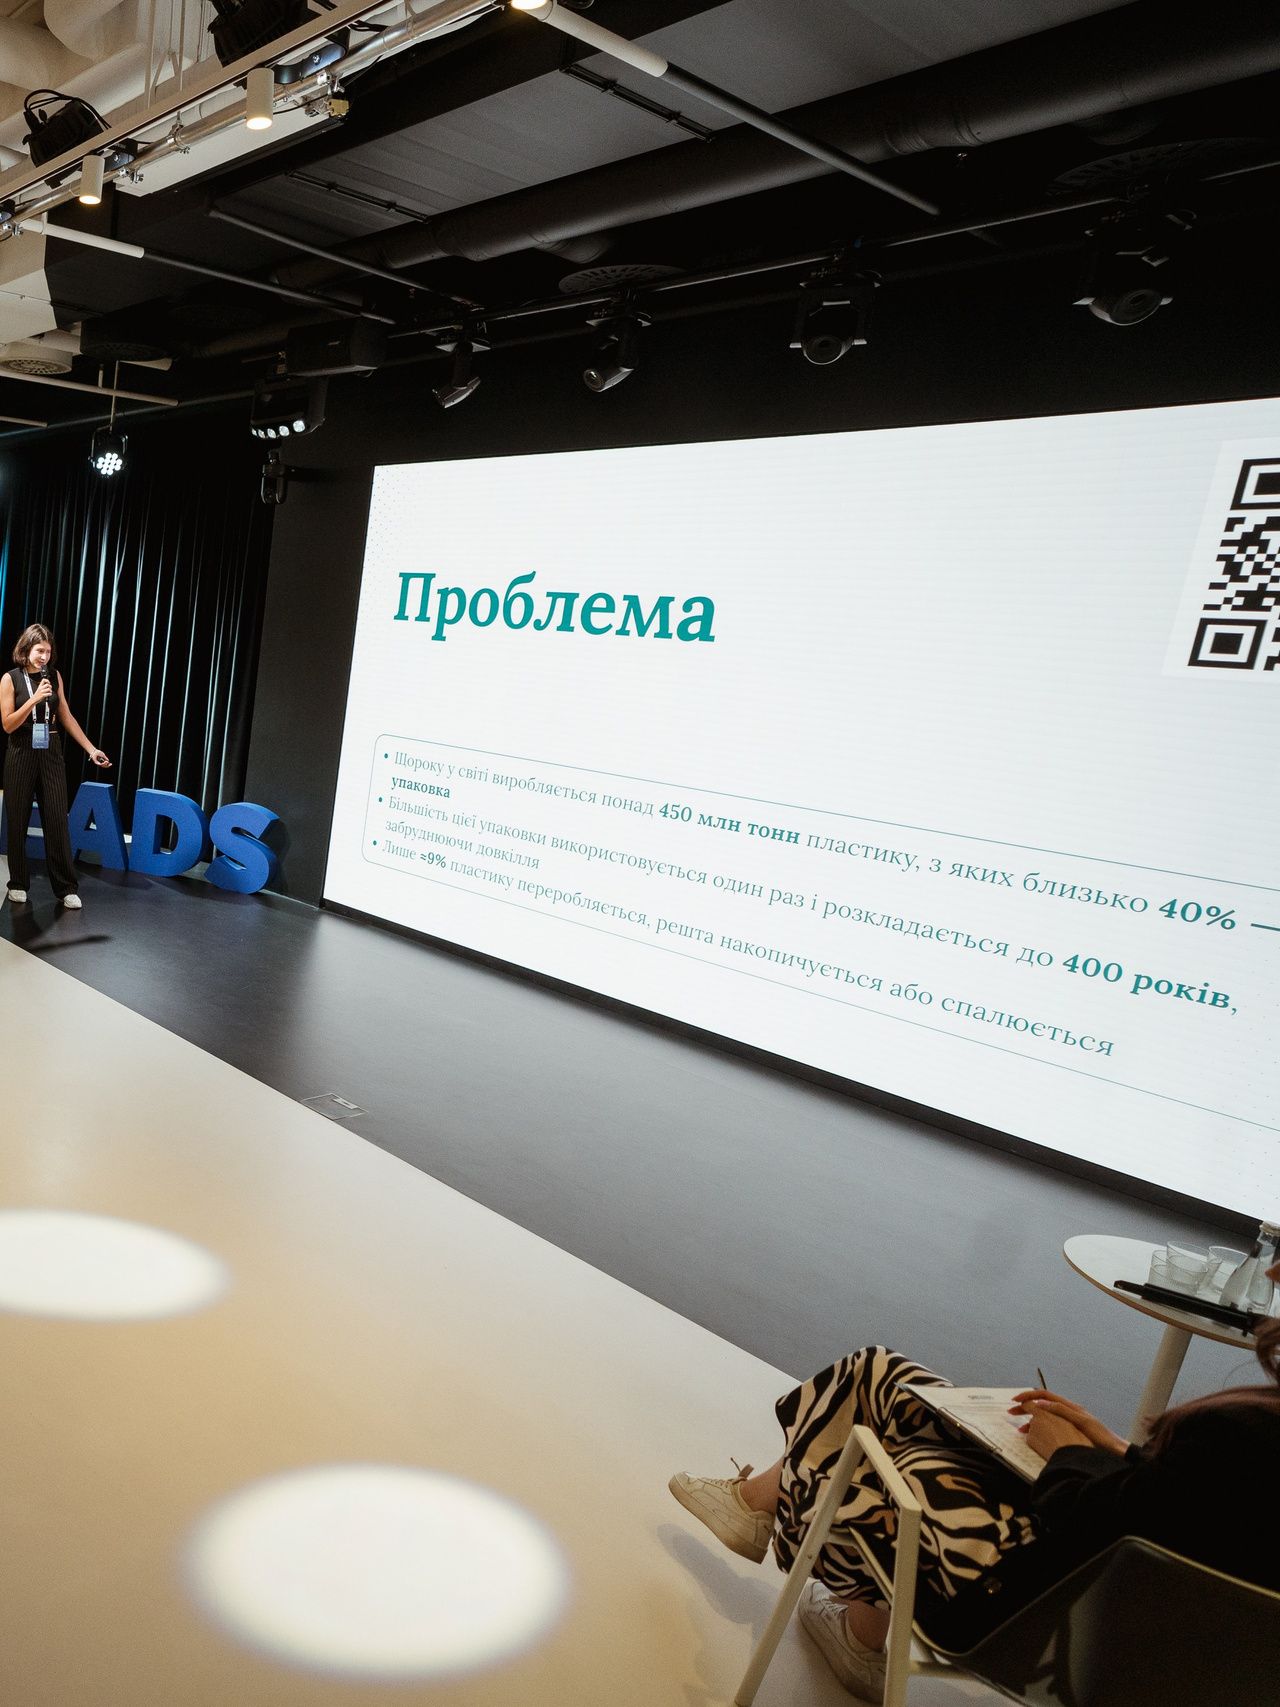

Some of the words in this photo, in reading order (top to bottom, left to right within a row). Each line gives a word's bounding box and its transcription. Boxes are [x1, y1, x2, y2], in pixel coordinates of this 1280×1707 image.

[393, 570, 716, 642] Проблема
[385, 820, 473, 851] забруднюючи
[476, 843, 541, 870] довкілля
[391, 776, 451, 798] упаковка
[394, 751, 445, 774] Щороку
[447, 764, 456, 779] у
[458, 766, 489, 782] світі
[492, 774, 597, 804] виробляється
[601, 794, 654, 817] понад
[658, 802, 693, 823] 450
[697, 813, 741, 833] млн
[747, 824, 800, 845] тонн
[806, 833, 921, 873] пластику,
[928, 857, 942, 873] з
[948, 862, 1015, 888] яких
[1022, 871, 1149, 914] близько
[1158, 898, 1237, 931] 40%
[382, 839, 417, 860] Лише
[450, 860, 515, 891] пластику
[517, 878, 651, 930] переробляється,
[655, 916, 714, 945] решта
[720, 935, 883, 992] накопичується
[889, 982, 933, 1006] або
[941, 996, 1115, 1057] спалюється
[388, 796, 449, 822] Більшість
[451, 812, 477, 828] цієї
[479, 819, 547, 846] упаковки
[551, 836, 708, 885] використовується
[712, 874, 764, 898] один
[768, 887, 805, 908] раз
[811, 894, 818, 911] і
[822, 899, 1010, 957] розкладається
[1016, 946, 1054, 967] до
[1062, 954, 1123, 983] 400
[1130, 972, 1238, 1016] років,
